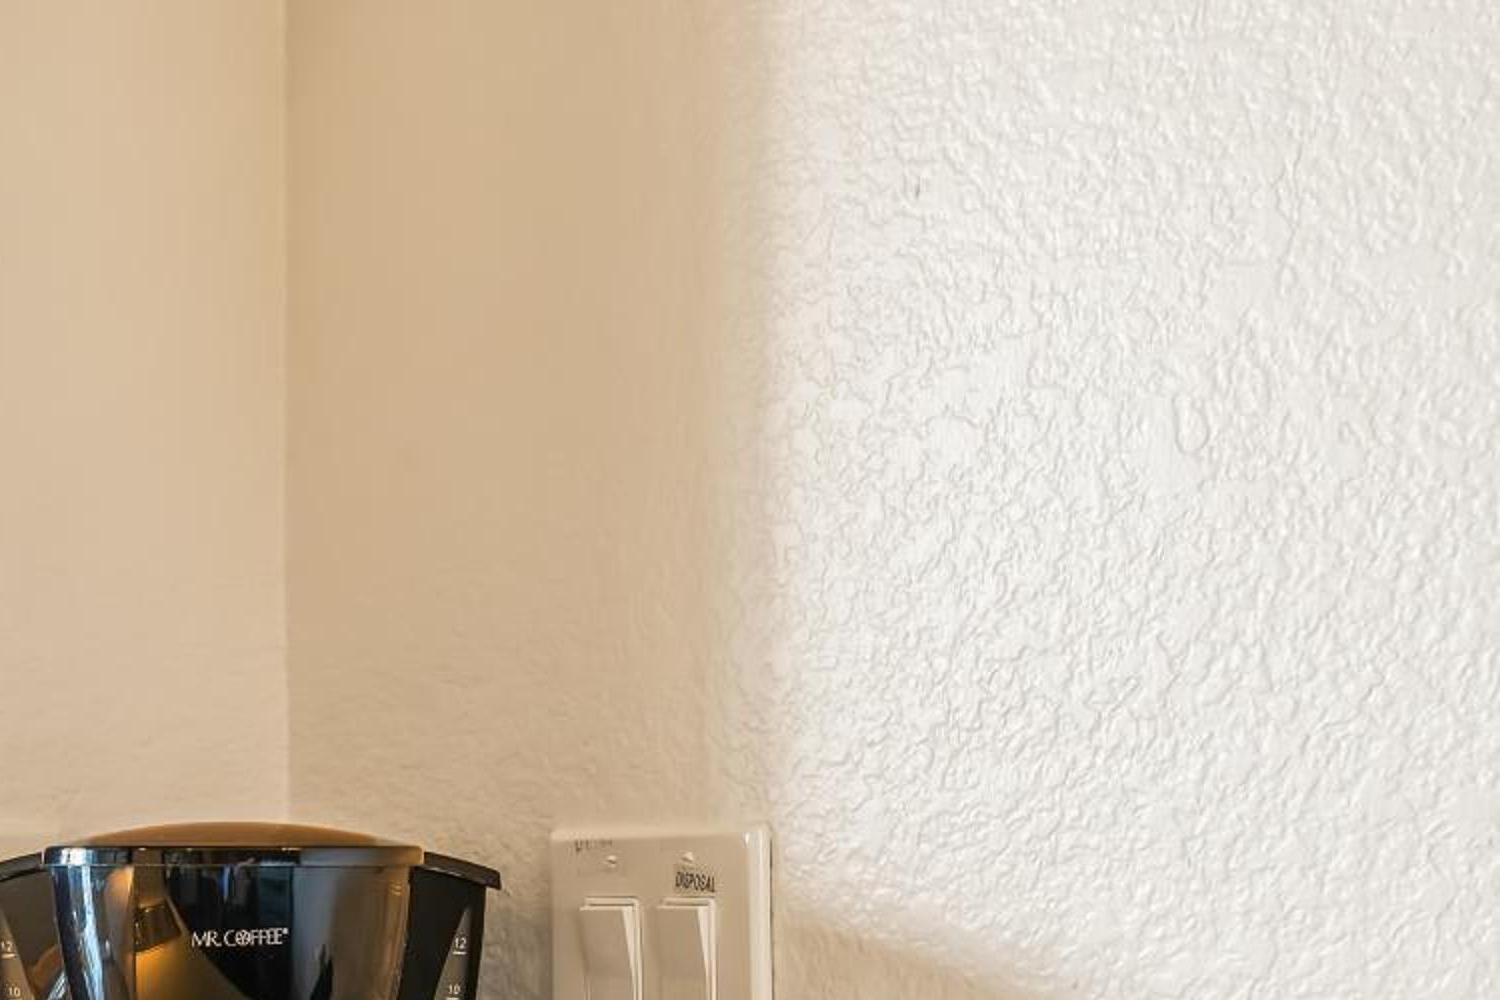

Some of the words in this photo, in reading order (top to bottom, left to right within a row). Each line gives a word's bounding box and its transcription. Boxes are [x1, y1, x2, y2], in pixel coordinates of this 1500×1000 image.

[455, 937, 467, 949] 12
[9, 986, 21, 997] 10
[448, 984, 461, 995] 10
